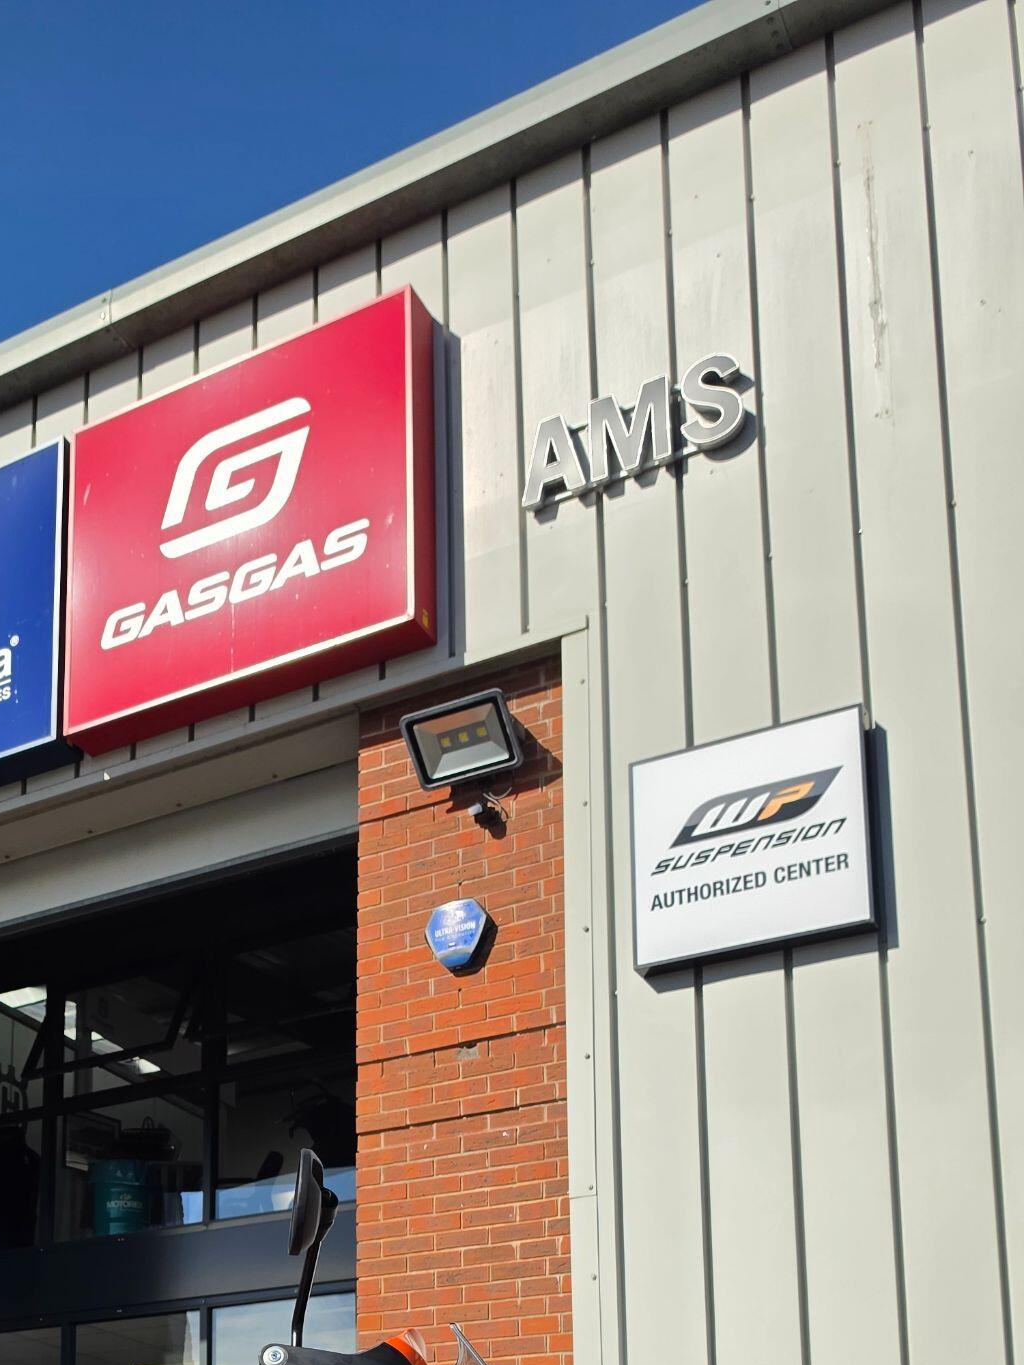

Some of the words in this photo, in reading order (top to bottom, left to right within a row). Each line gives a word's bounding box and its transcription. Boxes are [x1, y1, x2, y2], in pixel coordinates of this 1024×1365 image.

[522, 353, 744, 507] AMS
[99, 518, 370, 651] GASGAS
[650, 817, 848, 877] SUSPENSION
[650, 871, 767, 911] AUTHORIZED
[773, 853, 850, 884] CENTER
